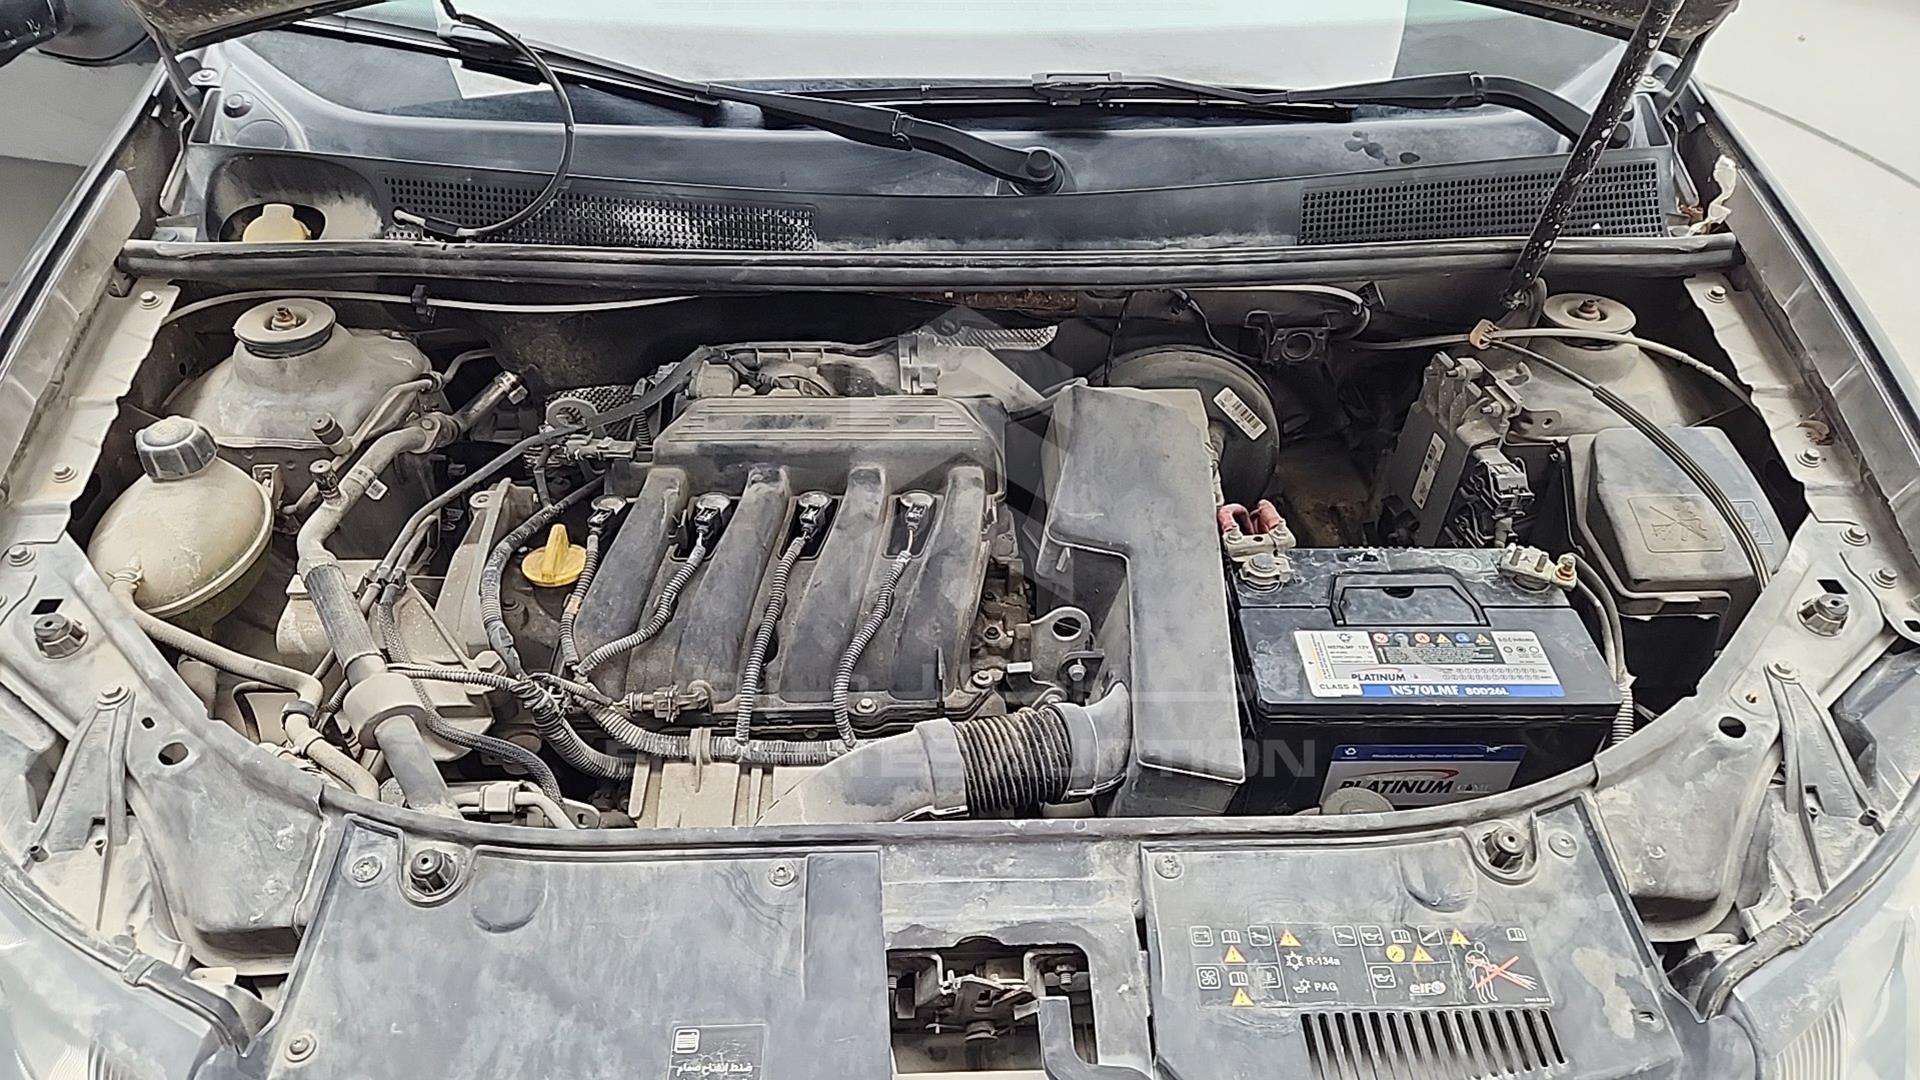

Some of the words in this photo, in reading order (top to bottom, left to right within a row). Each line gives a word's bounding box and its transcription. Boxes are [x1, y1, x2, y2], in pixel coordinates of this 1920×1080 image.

[1351, 673, 1406, 682] PLATINUM
[1391, 685, 1459, 696] NS70LMF
[1464, 686, 1510, 696] 80D26L
[1306, 956, 1341, 966] R-134a
[1314, 982, 1337, 992] PAG
